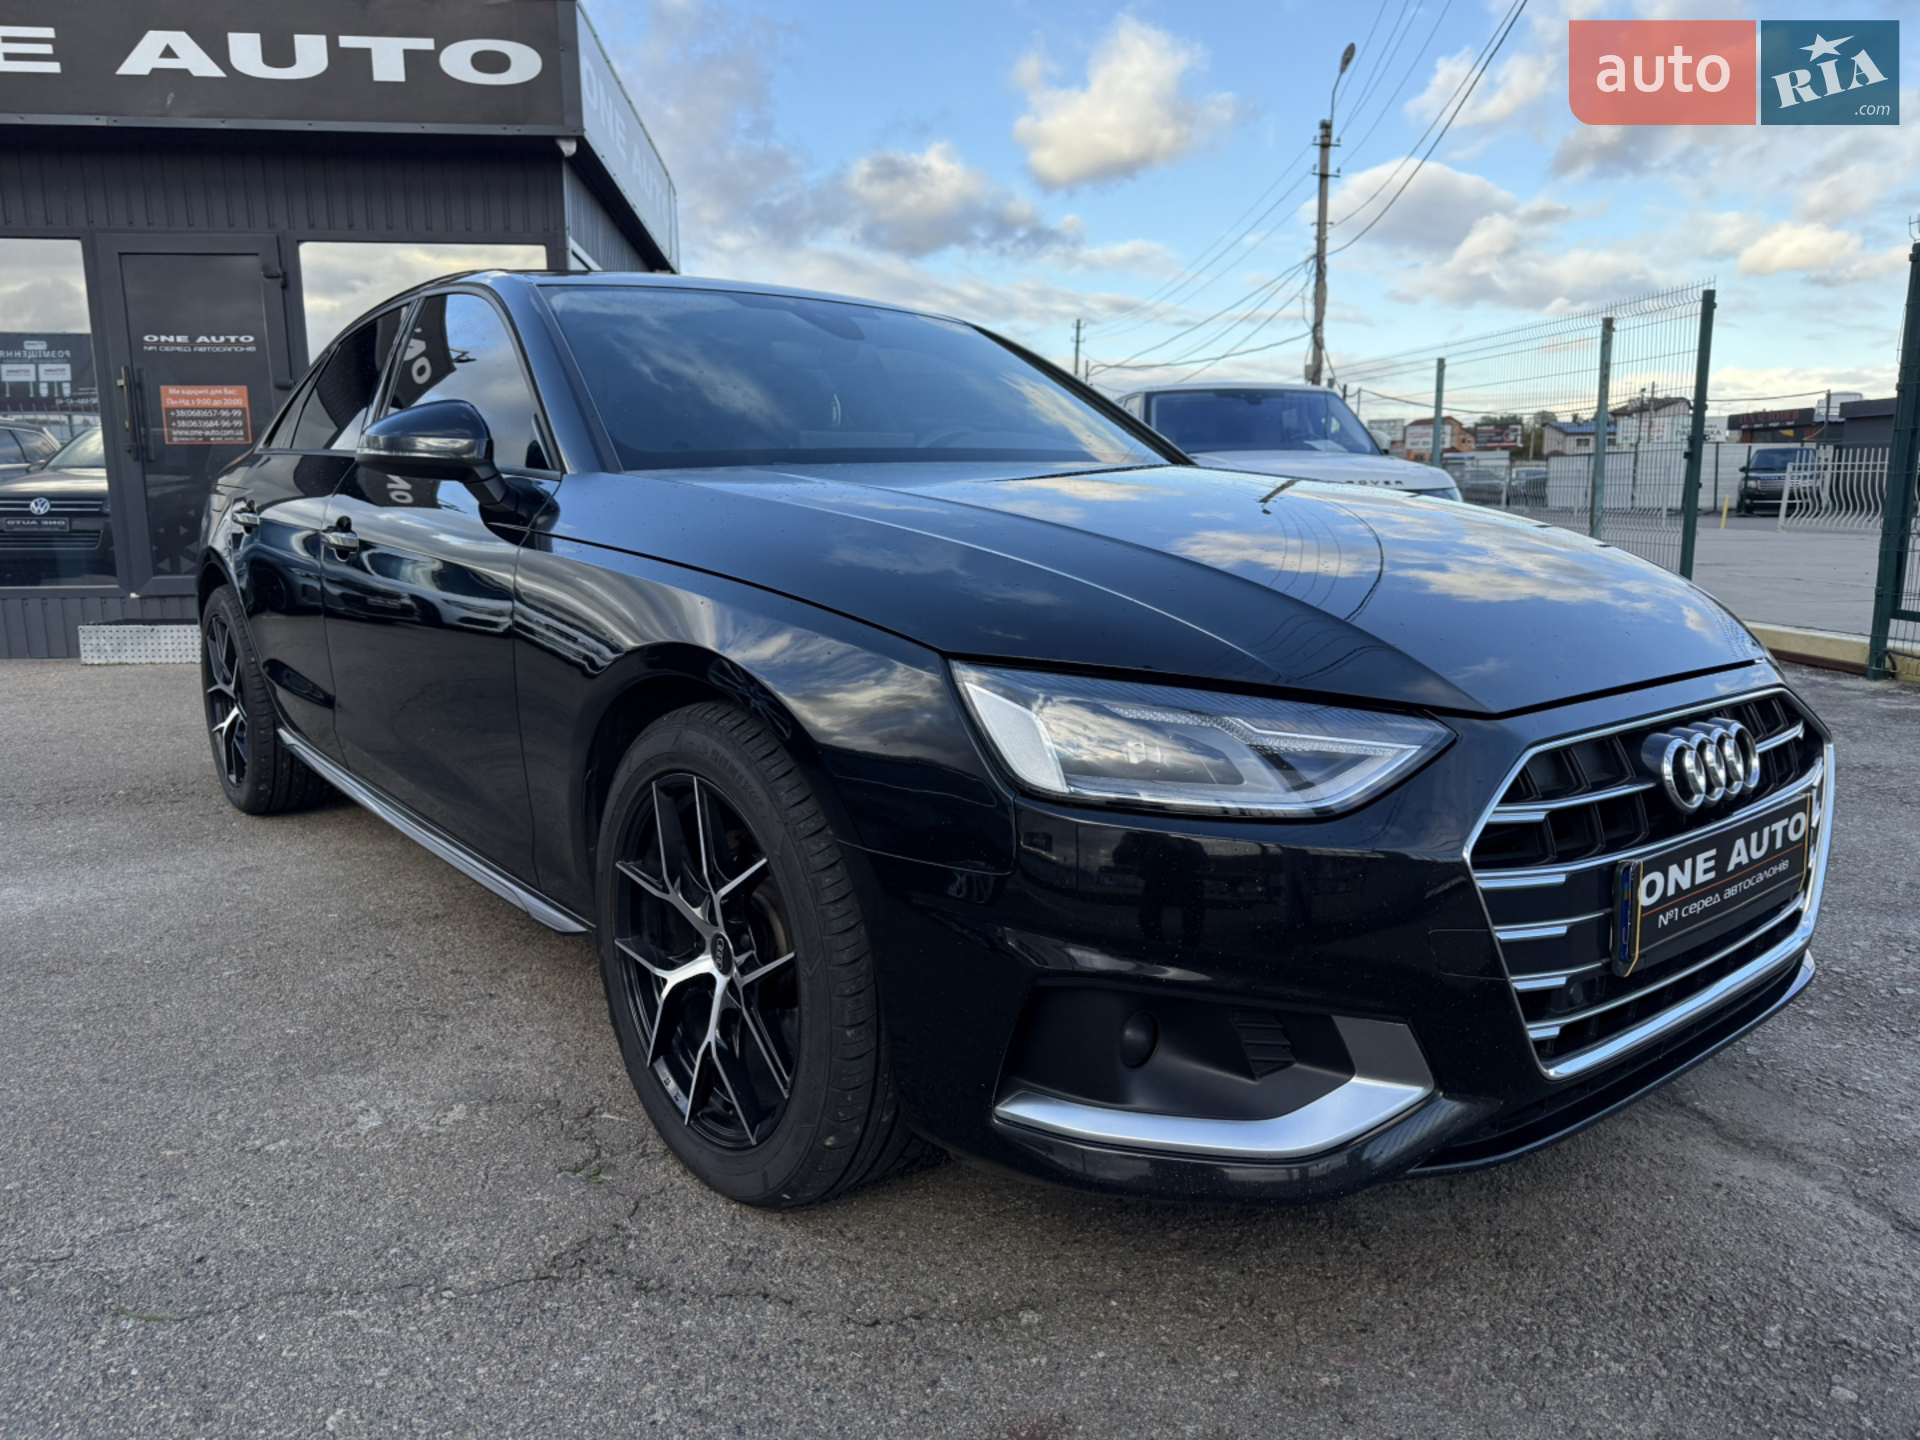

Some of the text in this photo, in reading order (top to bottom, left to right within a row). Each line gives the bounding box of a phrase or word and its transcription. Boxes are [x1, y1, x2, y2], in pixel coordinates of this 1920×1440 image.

[115, 30, 542, 85] AUTO
[582, 53, 627, 163] ONE
[143, 334, 255, 343] ONE AUTO
[1639, 811, 1808, 907] ONE AUTO
[1658, 859, 1790, 928] №1 серед автосалонів
